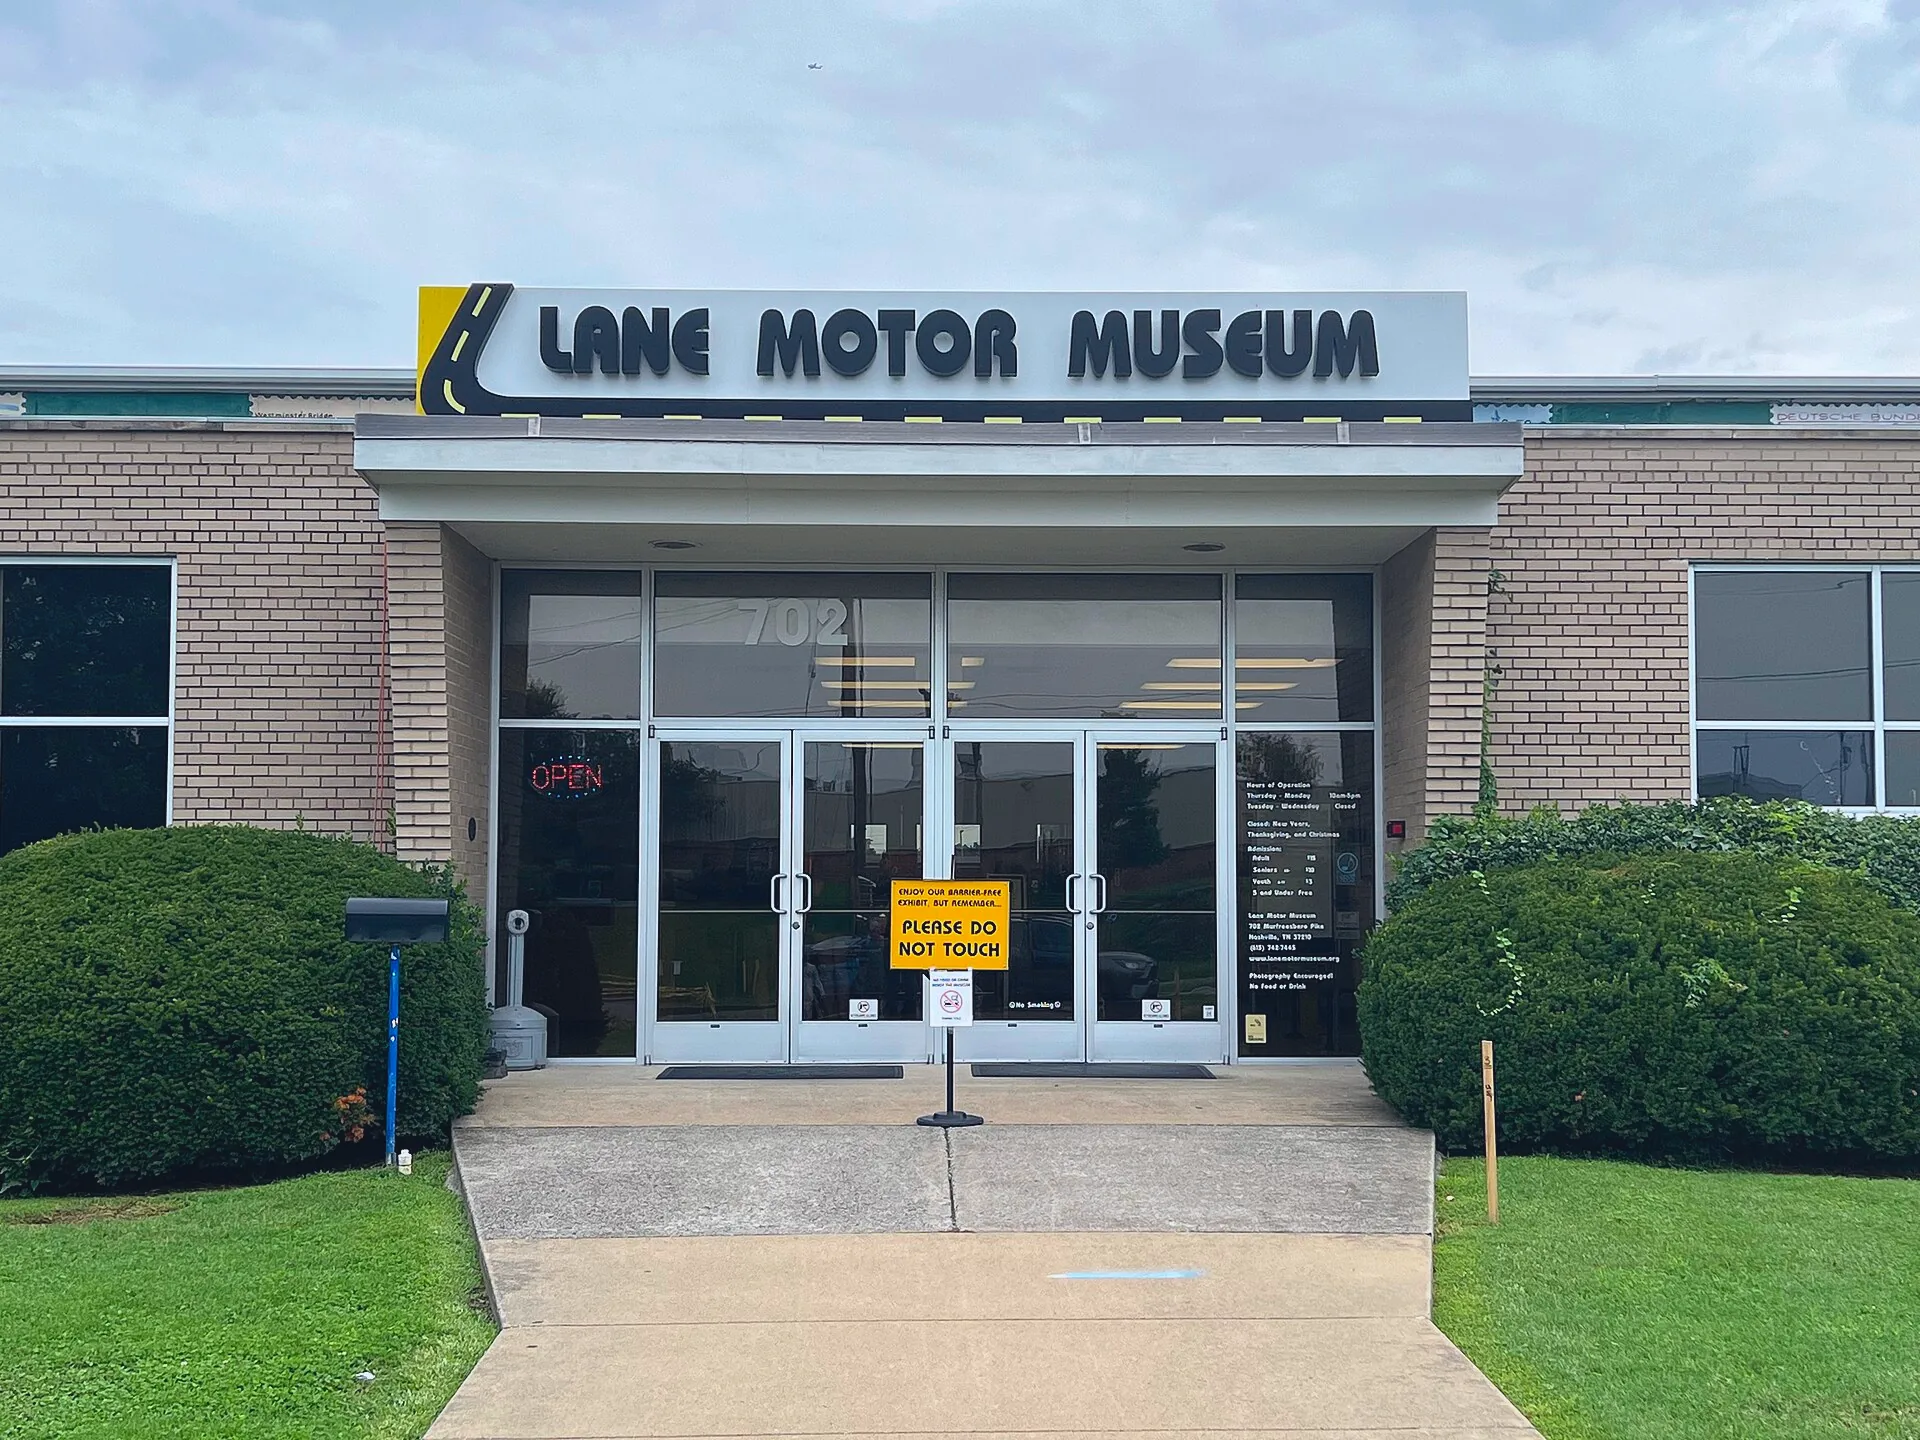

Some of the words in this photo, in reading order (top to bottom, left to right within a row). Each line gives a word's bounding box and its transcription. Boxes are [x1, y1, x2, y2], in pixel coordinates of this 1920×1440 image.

[539, 306, 710, 377] LANE
[757, 308, 1019, 377] MOTOR
[1068, 309, 1379, 378] MUSEUM
[737, 598, 848, 646] 702
[532, 765, 602, 789] OPEN
[902, 920, 962, 934] PLEASE
[971, 921, 996, 935] DO
[899, 942, 935, 956] NOT
[943, 942, 1000, 956] TOUCH
